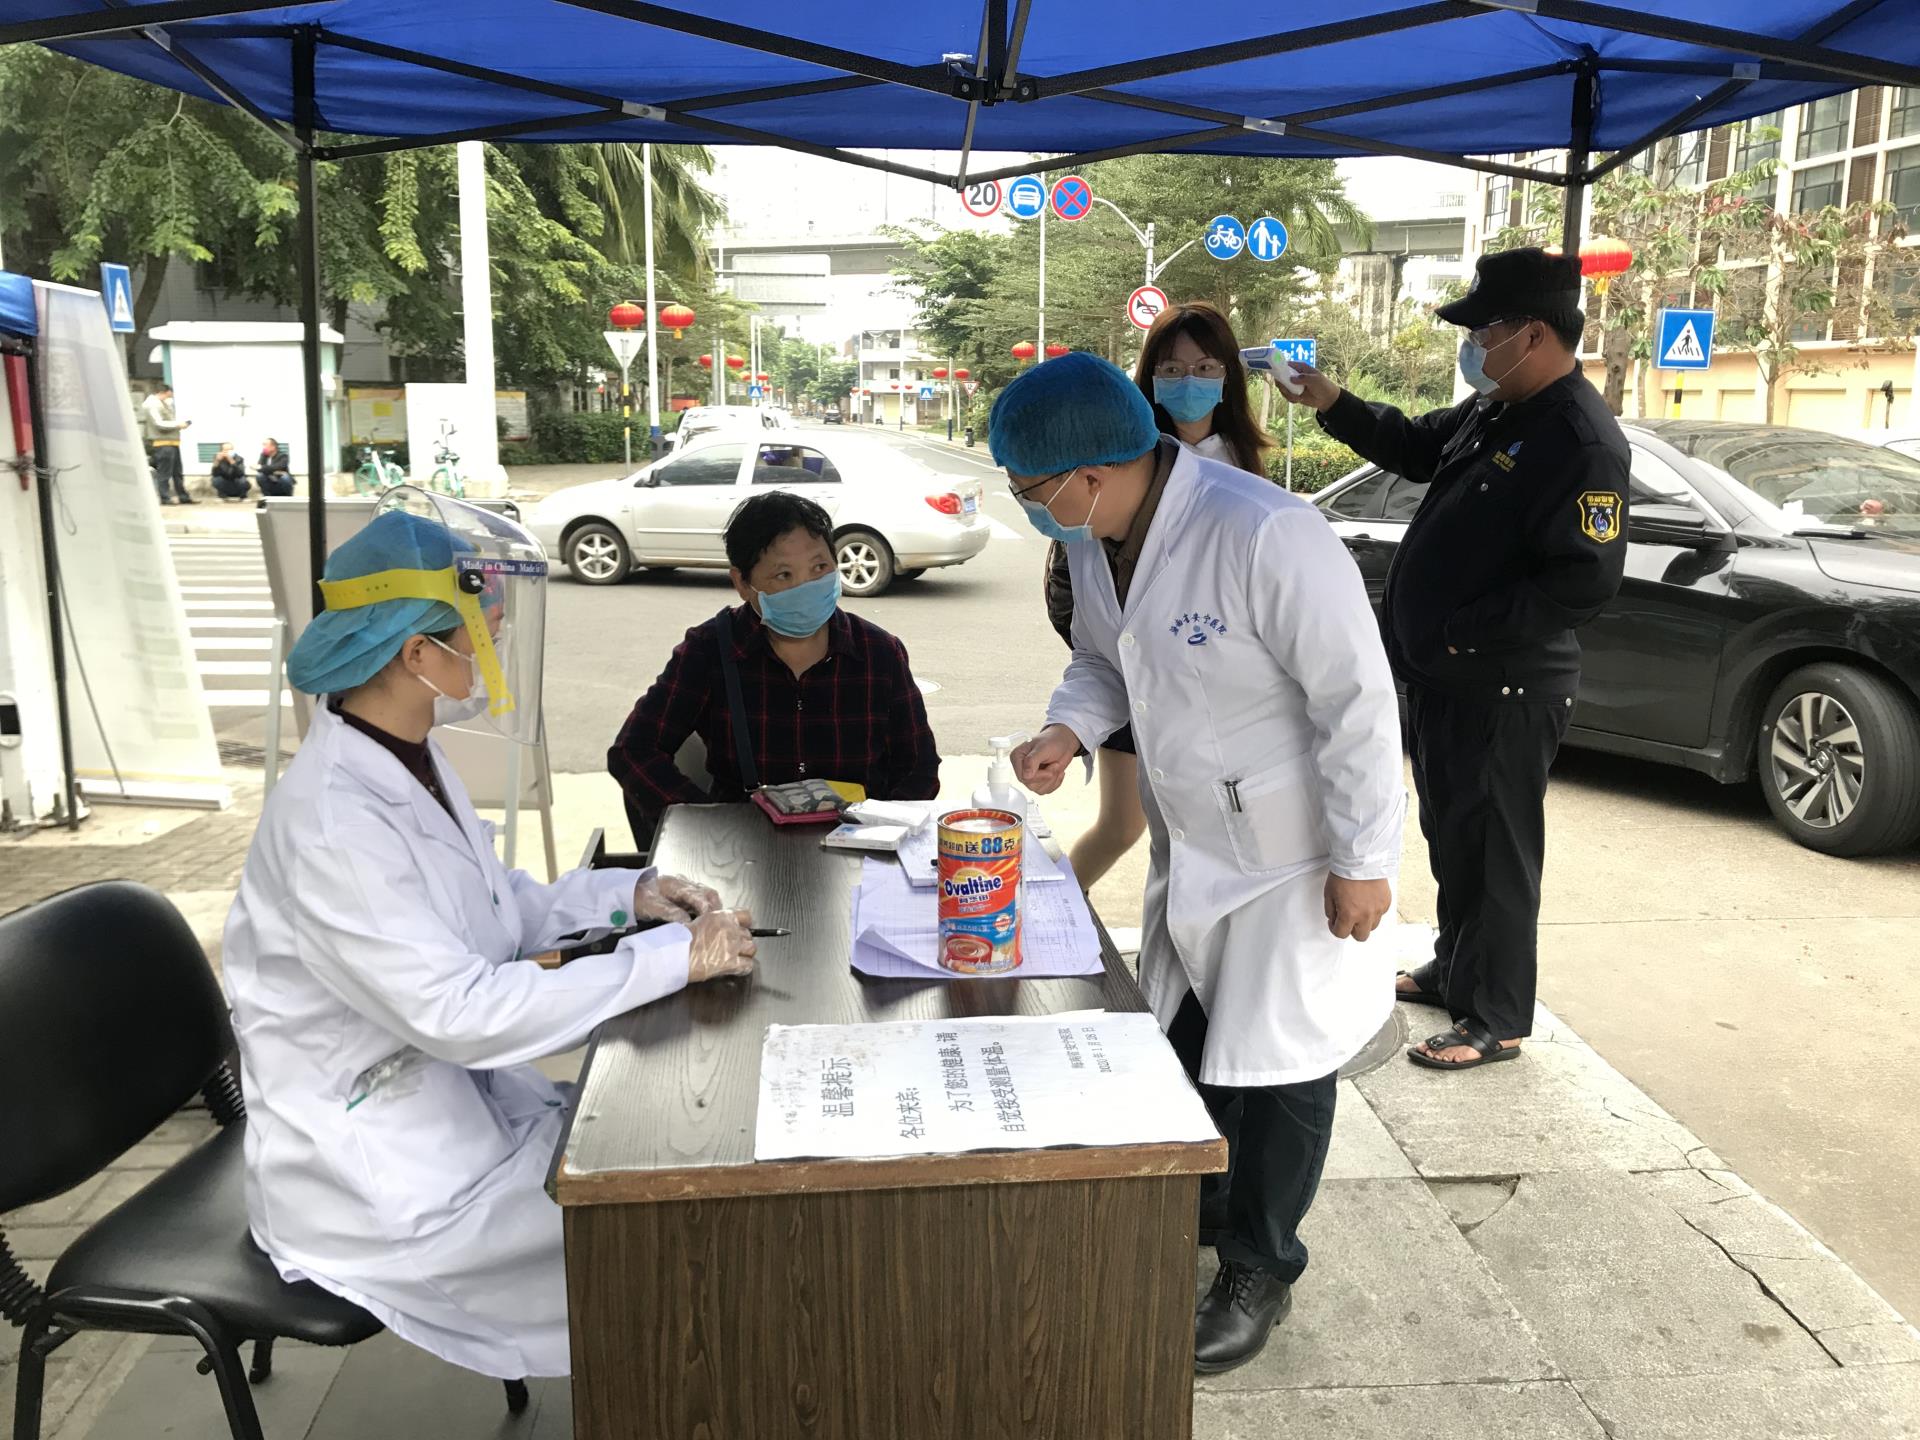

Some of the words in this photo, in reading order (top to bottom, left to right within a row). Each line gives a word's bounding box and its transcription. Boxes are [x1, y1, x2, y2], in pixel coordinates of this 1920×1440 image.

[969, 183, 996, 206] 20
[462, 561, 483, 570] Made
[485, 561, 493, 570] in
[494, 562, 515, 572] China
[520, 563, 535, 572] Made
[944, 876, 1002, 896] Ovaltine
[820, 1057, 854, 1117] 温馨提示
[981, 1041, 1027, 1132] 自觉接受测量体温。
